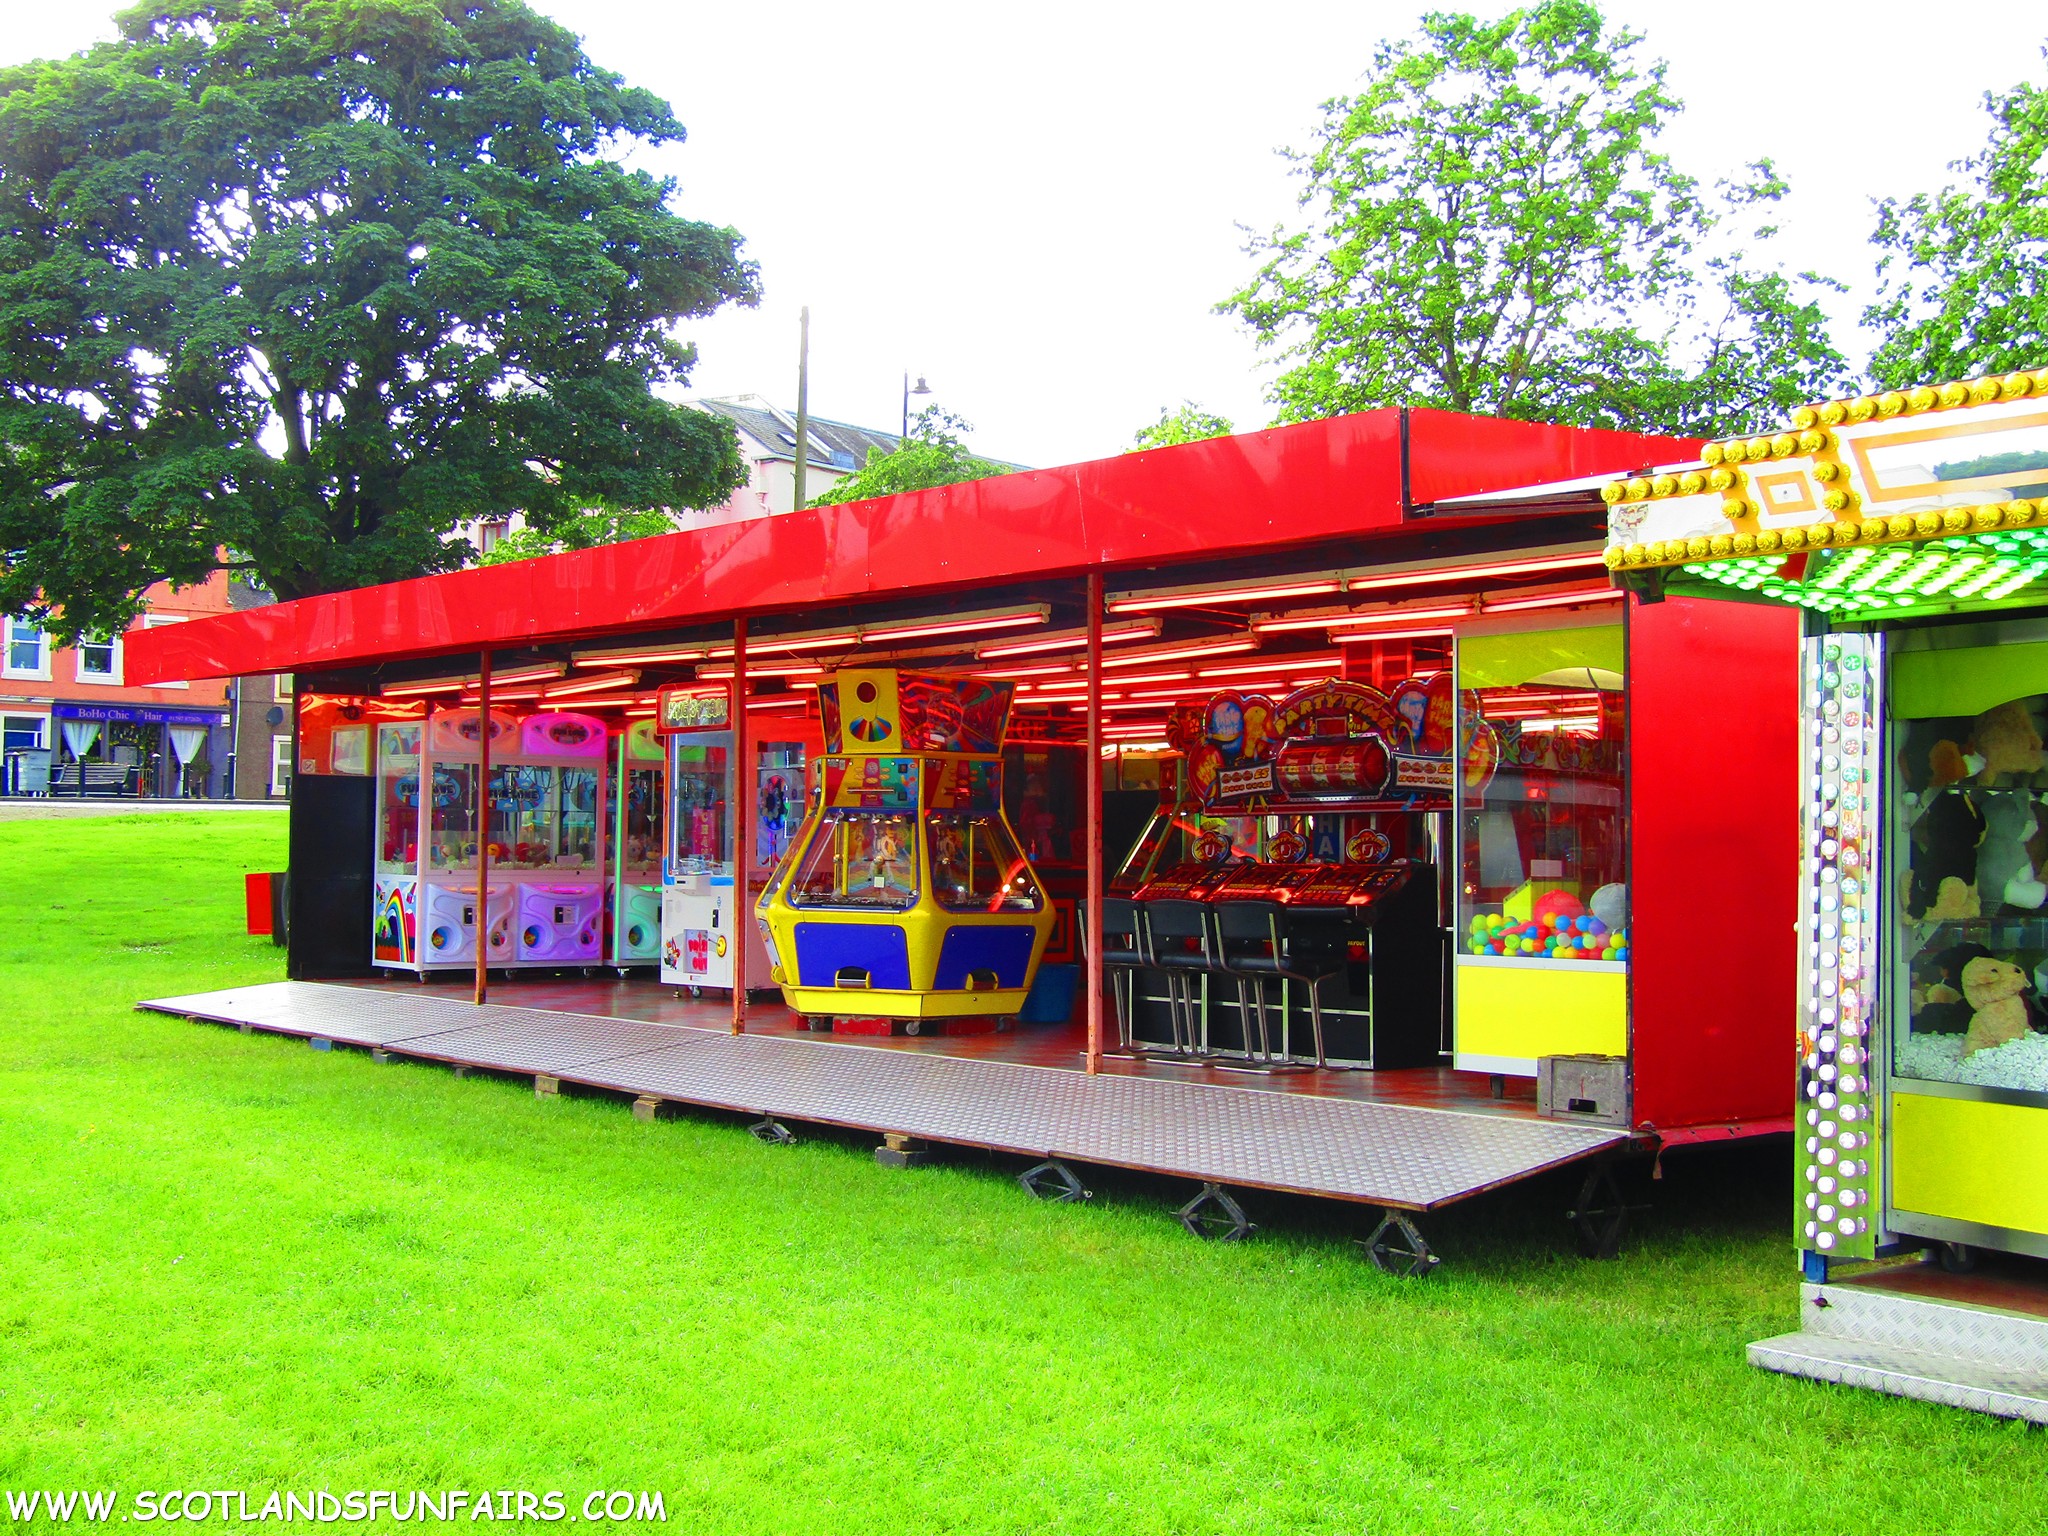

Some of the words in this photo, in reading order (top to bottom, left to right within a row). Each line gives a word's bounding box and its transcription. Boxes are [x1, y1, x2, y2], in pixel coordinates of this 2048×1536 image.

[78, 708, 106, 719] BoHo
[108, 709, 129, 720] Chic
[144, 711, 162, 721] Hair
[1275, 695, 1342, 735] PARTY
